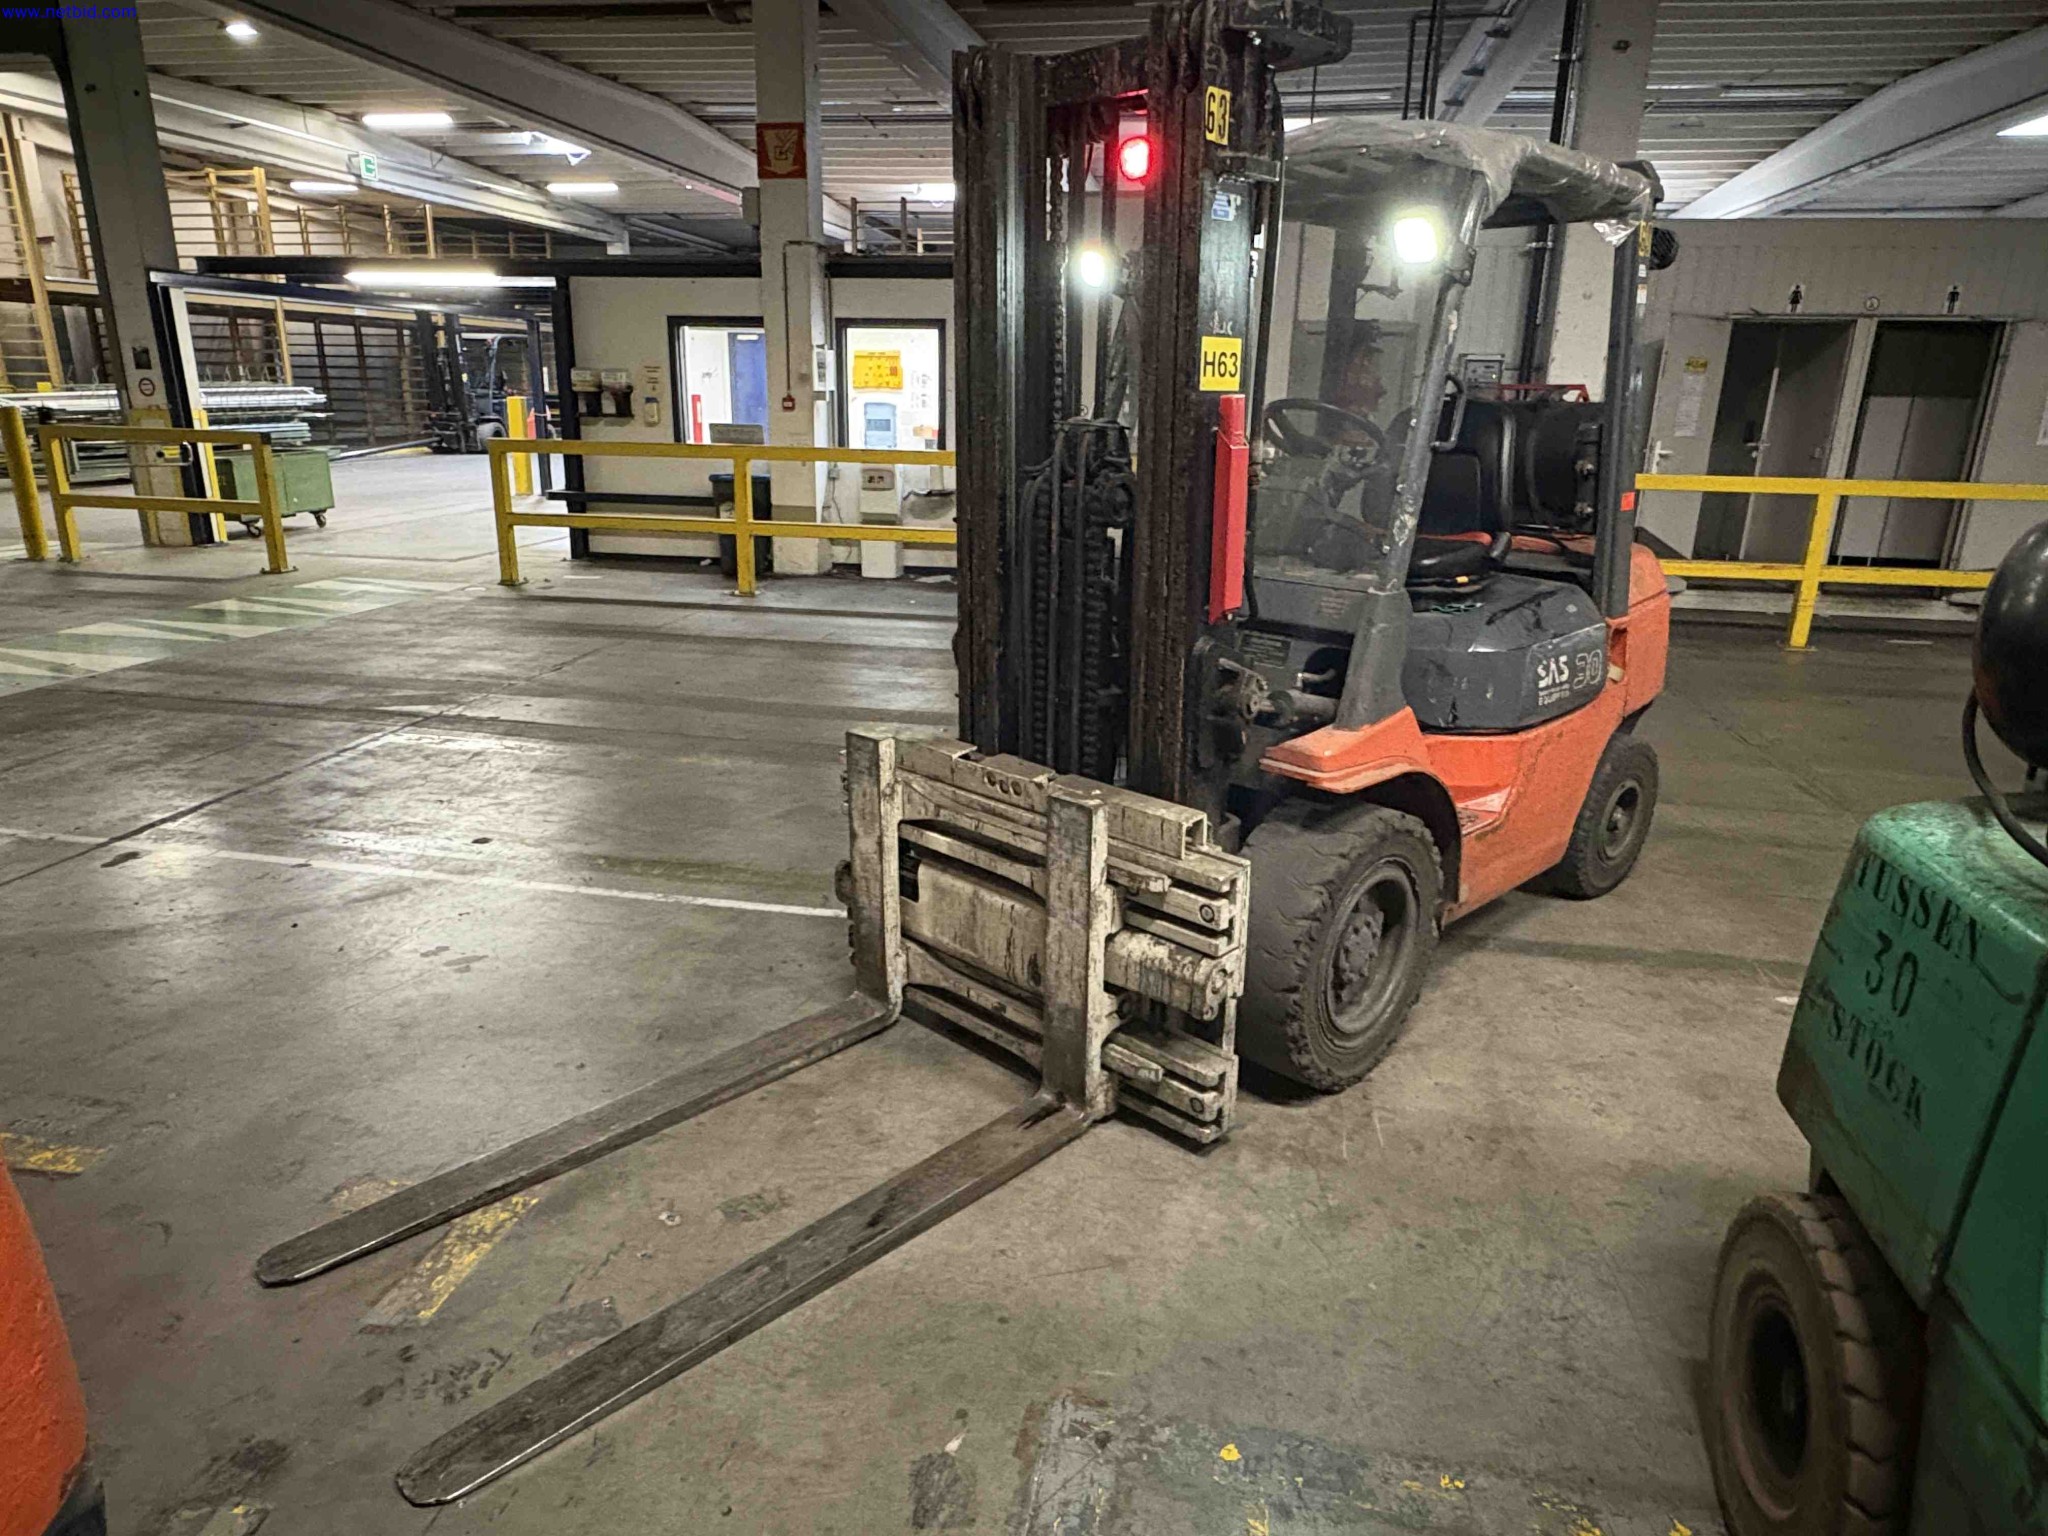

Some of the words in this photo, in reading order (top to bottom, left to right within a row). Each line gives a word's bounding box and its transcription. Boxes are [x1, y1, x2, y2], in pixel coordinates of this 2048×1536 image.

[1206, 91, 1228, 140] 63
[1203, 350, 1239, 378] H63
[1537, 654, 1570, 689] SAS
[1572, 648, 1603, 690] 30
[1865, 929, 1919, 1018] 30
